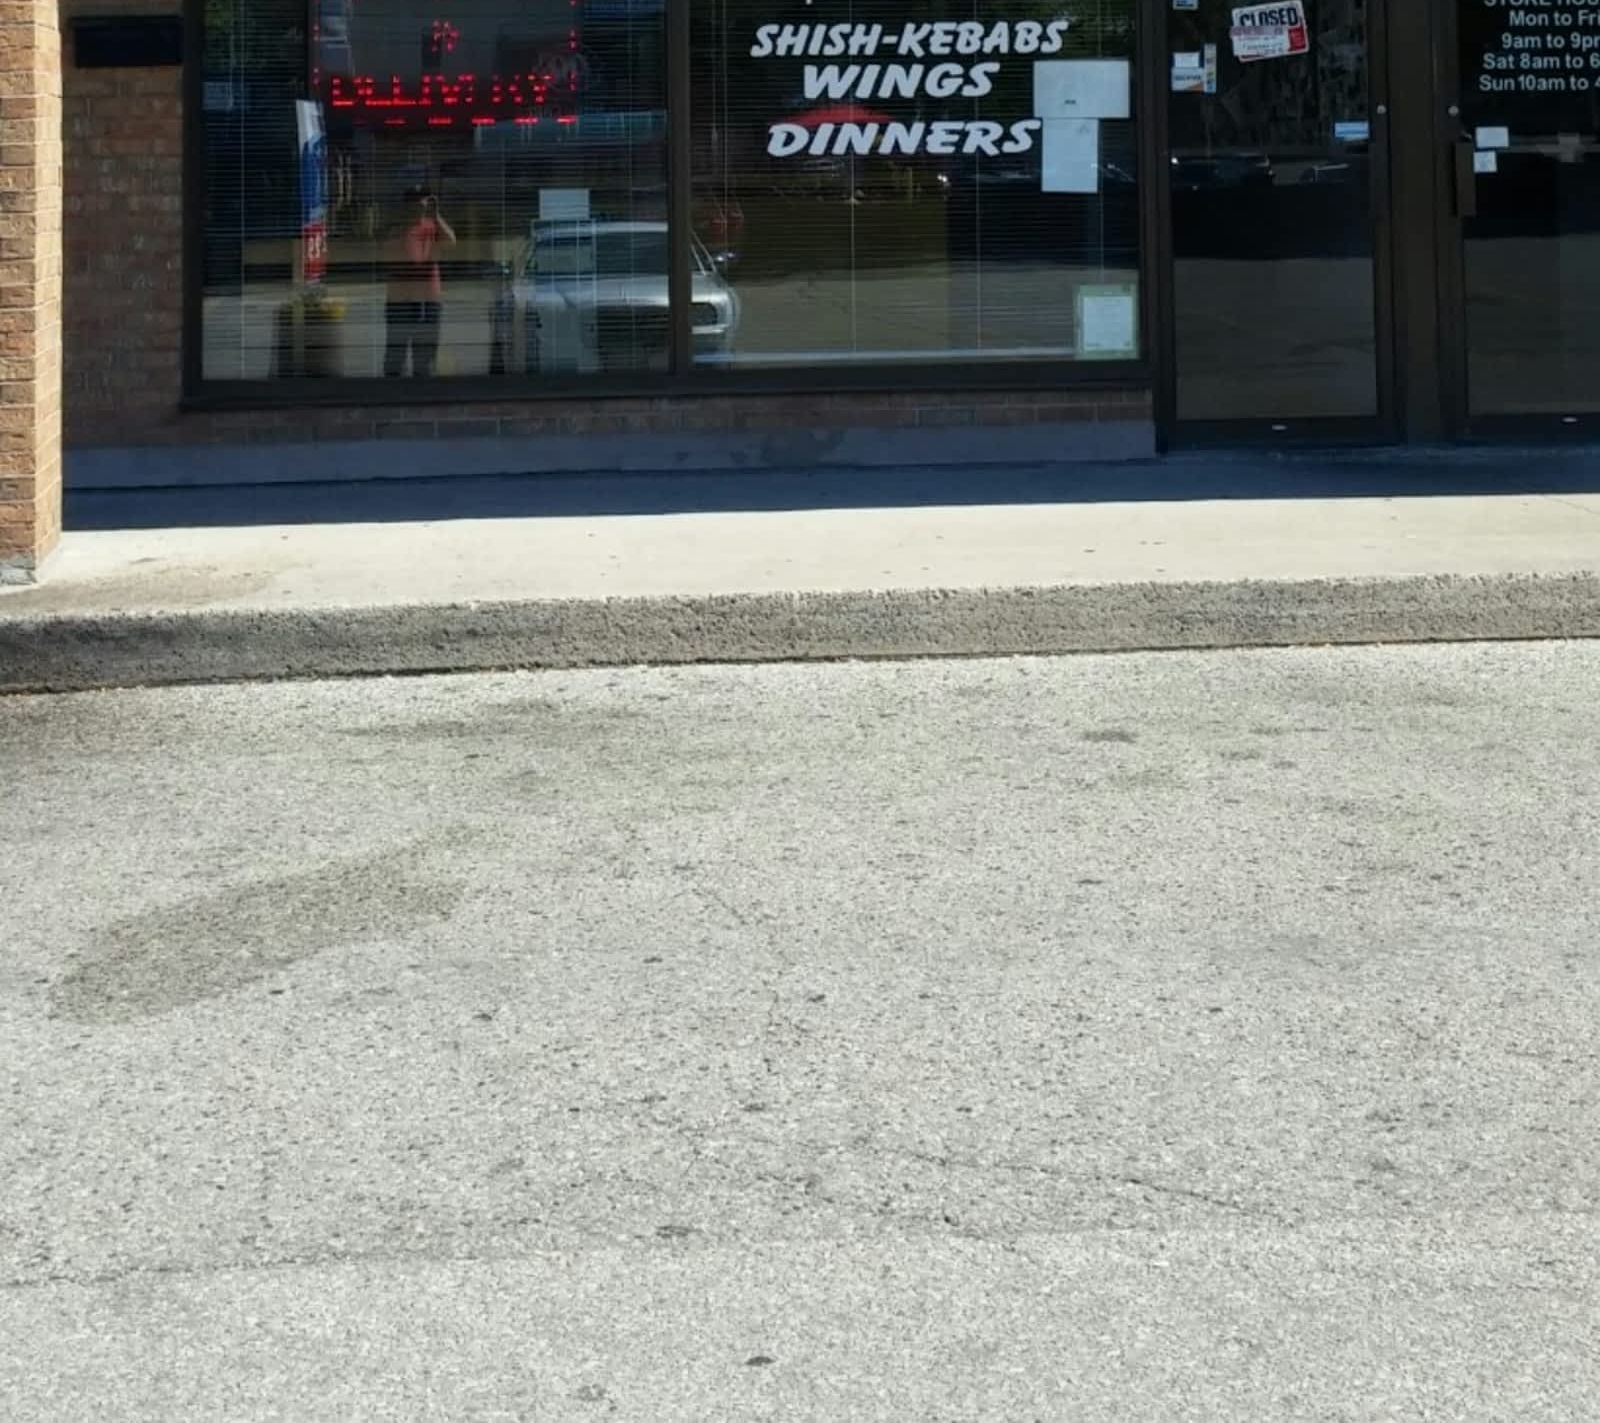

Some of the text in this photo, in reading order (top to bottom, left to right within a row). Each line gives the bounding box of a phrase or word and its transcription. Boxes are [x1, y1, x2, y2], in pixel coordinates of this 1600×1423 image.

[1239, 6, 1299, 27] CLOSED
[1509, 10, 1549, 26] Mon
[1553, 11, 1573, 26] to
[750, 20, 1069, 58] SHISH-KEBABS
[1501, 31, 1541, 49] 9am
[1546, 33, 1565, 48] to
[1482, 52, 1516, 69] Sat
[1519, 52, 1560, 69] 8am
[1564, 53, 1584, 69] to
[803, 61, 1000, 100] WINGS
[1479, 73, 1516, 90] Sun
[1518, 73, 1566, 90] 10am
[1569, 74, 1589, 90] to
[767, 119, 1042, 157] DINNERS
